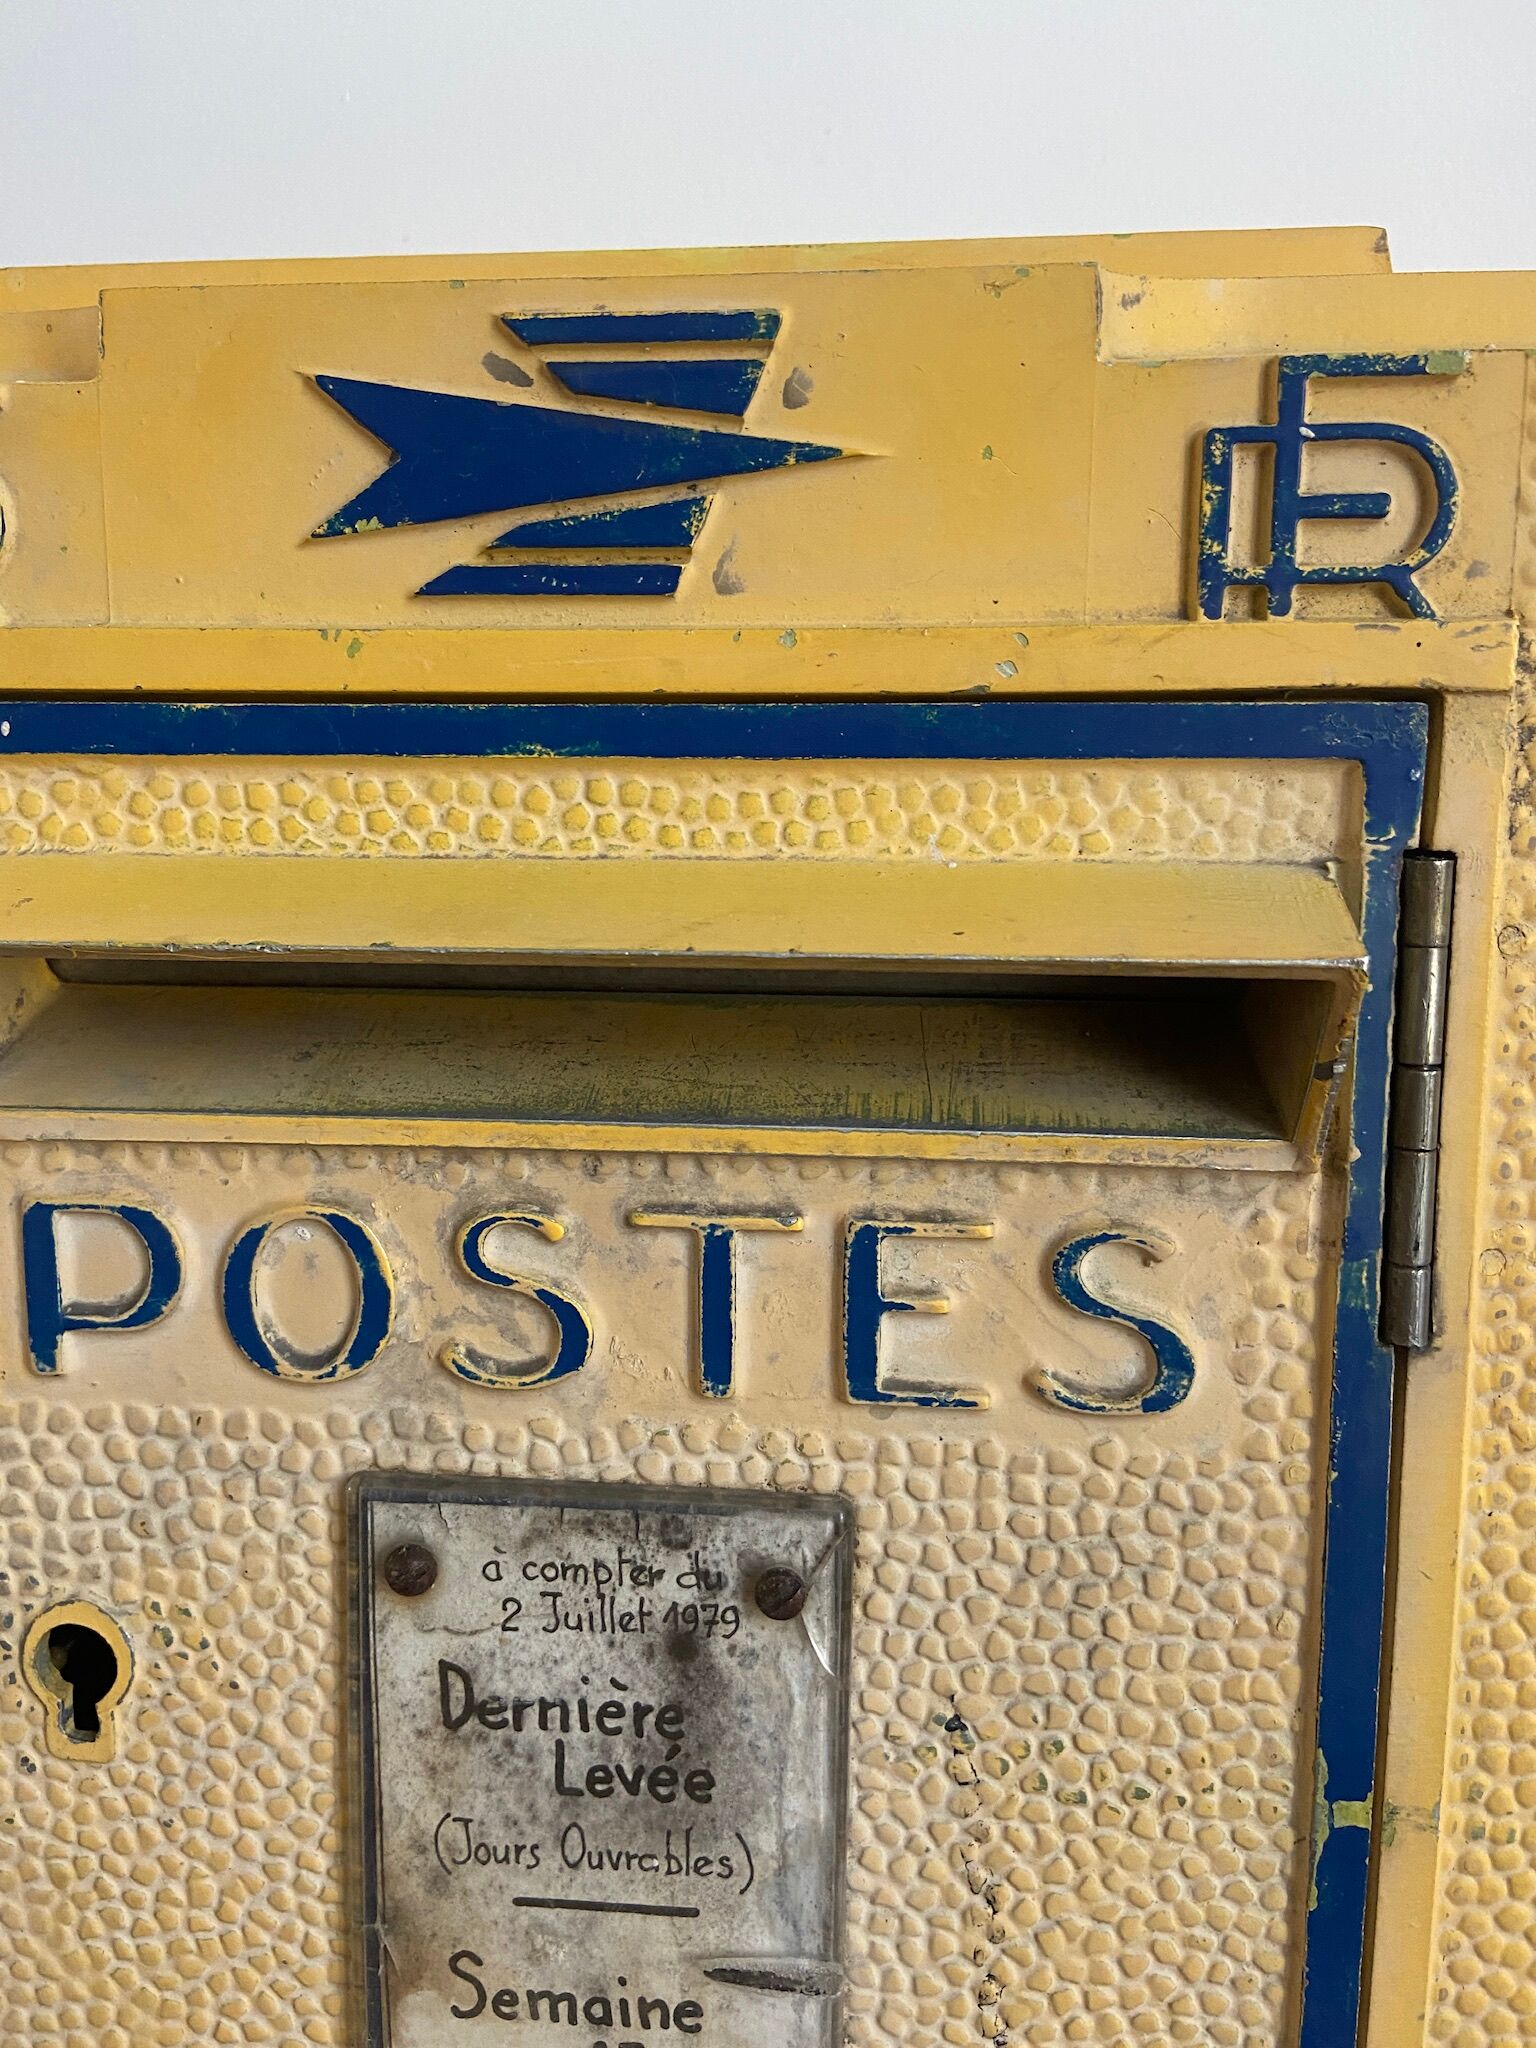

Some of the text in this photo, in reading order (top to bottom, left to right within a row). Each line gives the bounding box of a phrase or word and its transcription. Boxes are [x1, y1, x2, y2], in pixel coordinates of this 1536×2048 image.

[20, 1198, 1197, 1414] POSTES
[481, 1544, 726, 1600] à compter du
[499, 1591, 741, 1640] 2 Juillet 1979
[437, 1657, 686, 1741] Dernière
[553, 1738, 716, 1805] Levée
[432, 1812, 755, 1895] (Jours Ouvrables)
[448, 1948, 704, 2034] Semaine
